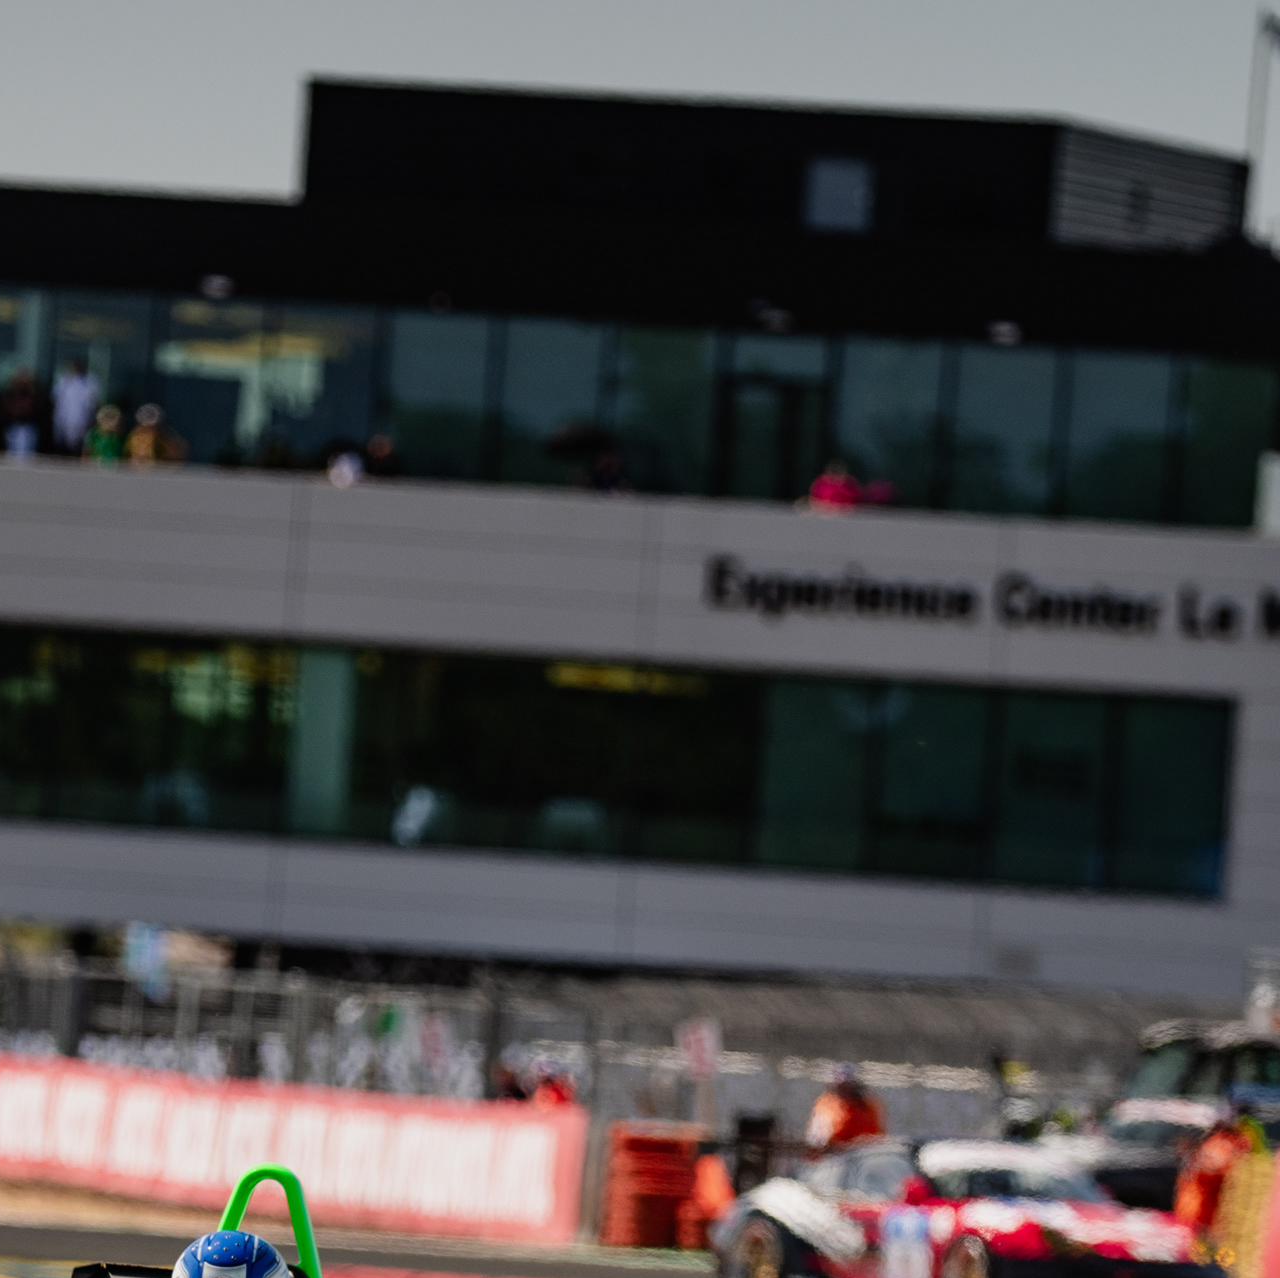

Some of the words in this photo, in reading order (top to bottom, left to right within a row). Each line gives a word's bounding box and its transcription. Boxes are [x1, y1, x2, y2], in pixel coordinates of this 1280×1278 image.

[704, 553, 977, 626] Experience
[994, 571, 1161, 636] Center
[1176, 582, 1243, 641] Le
